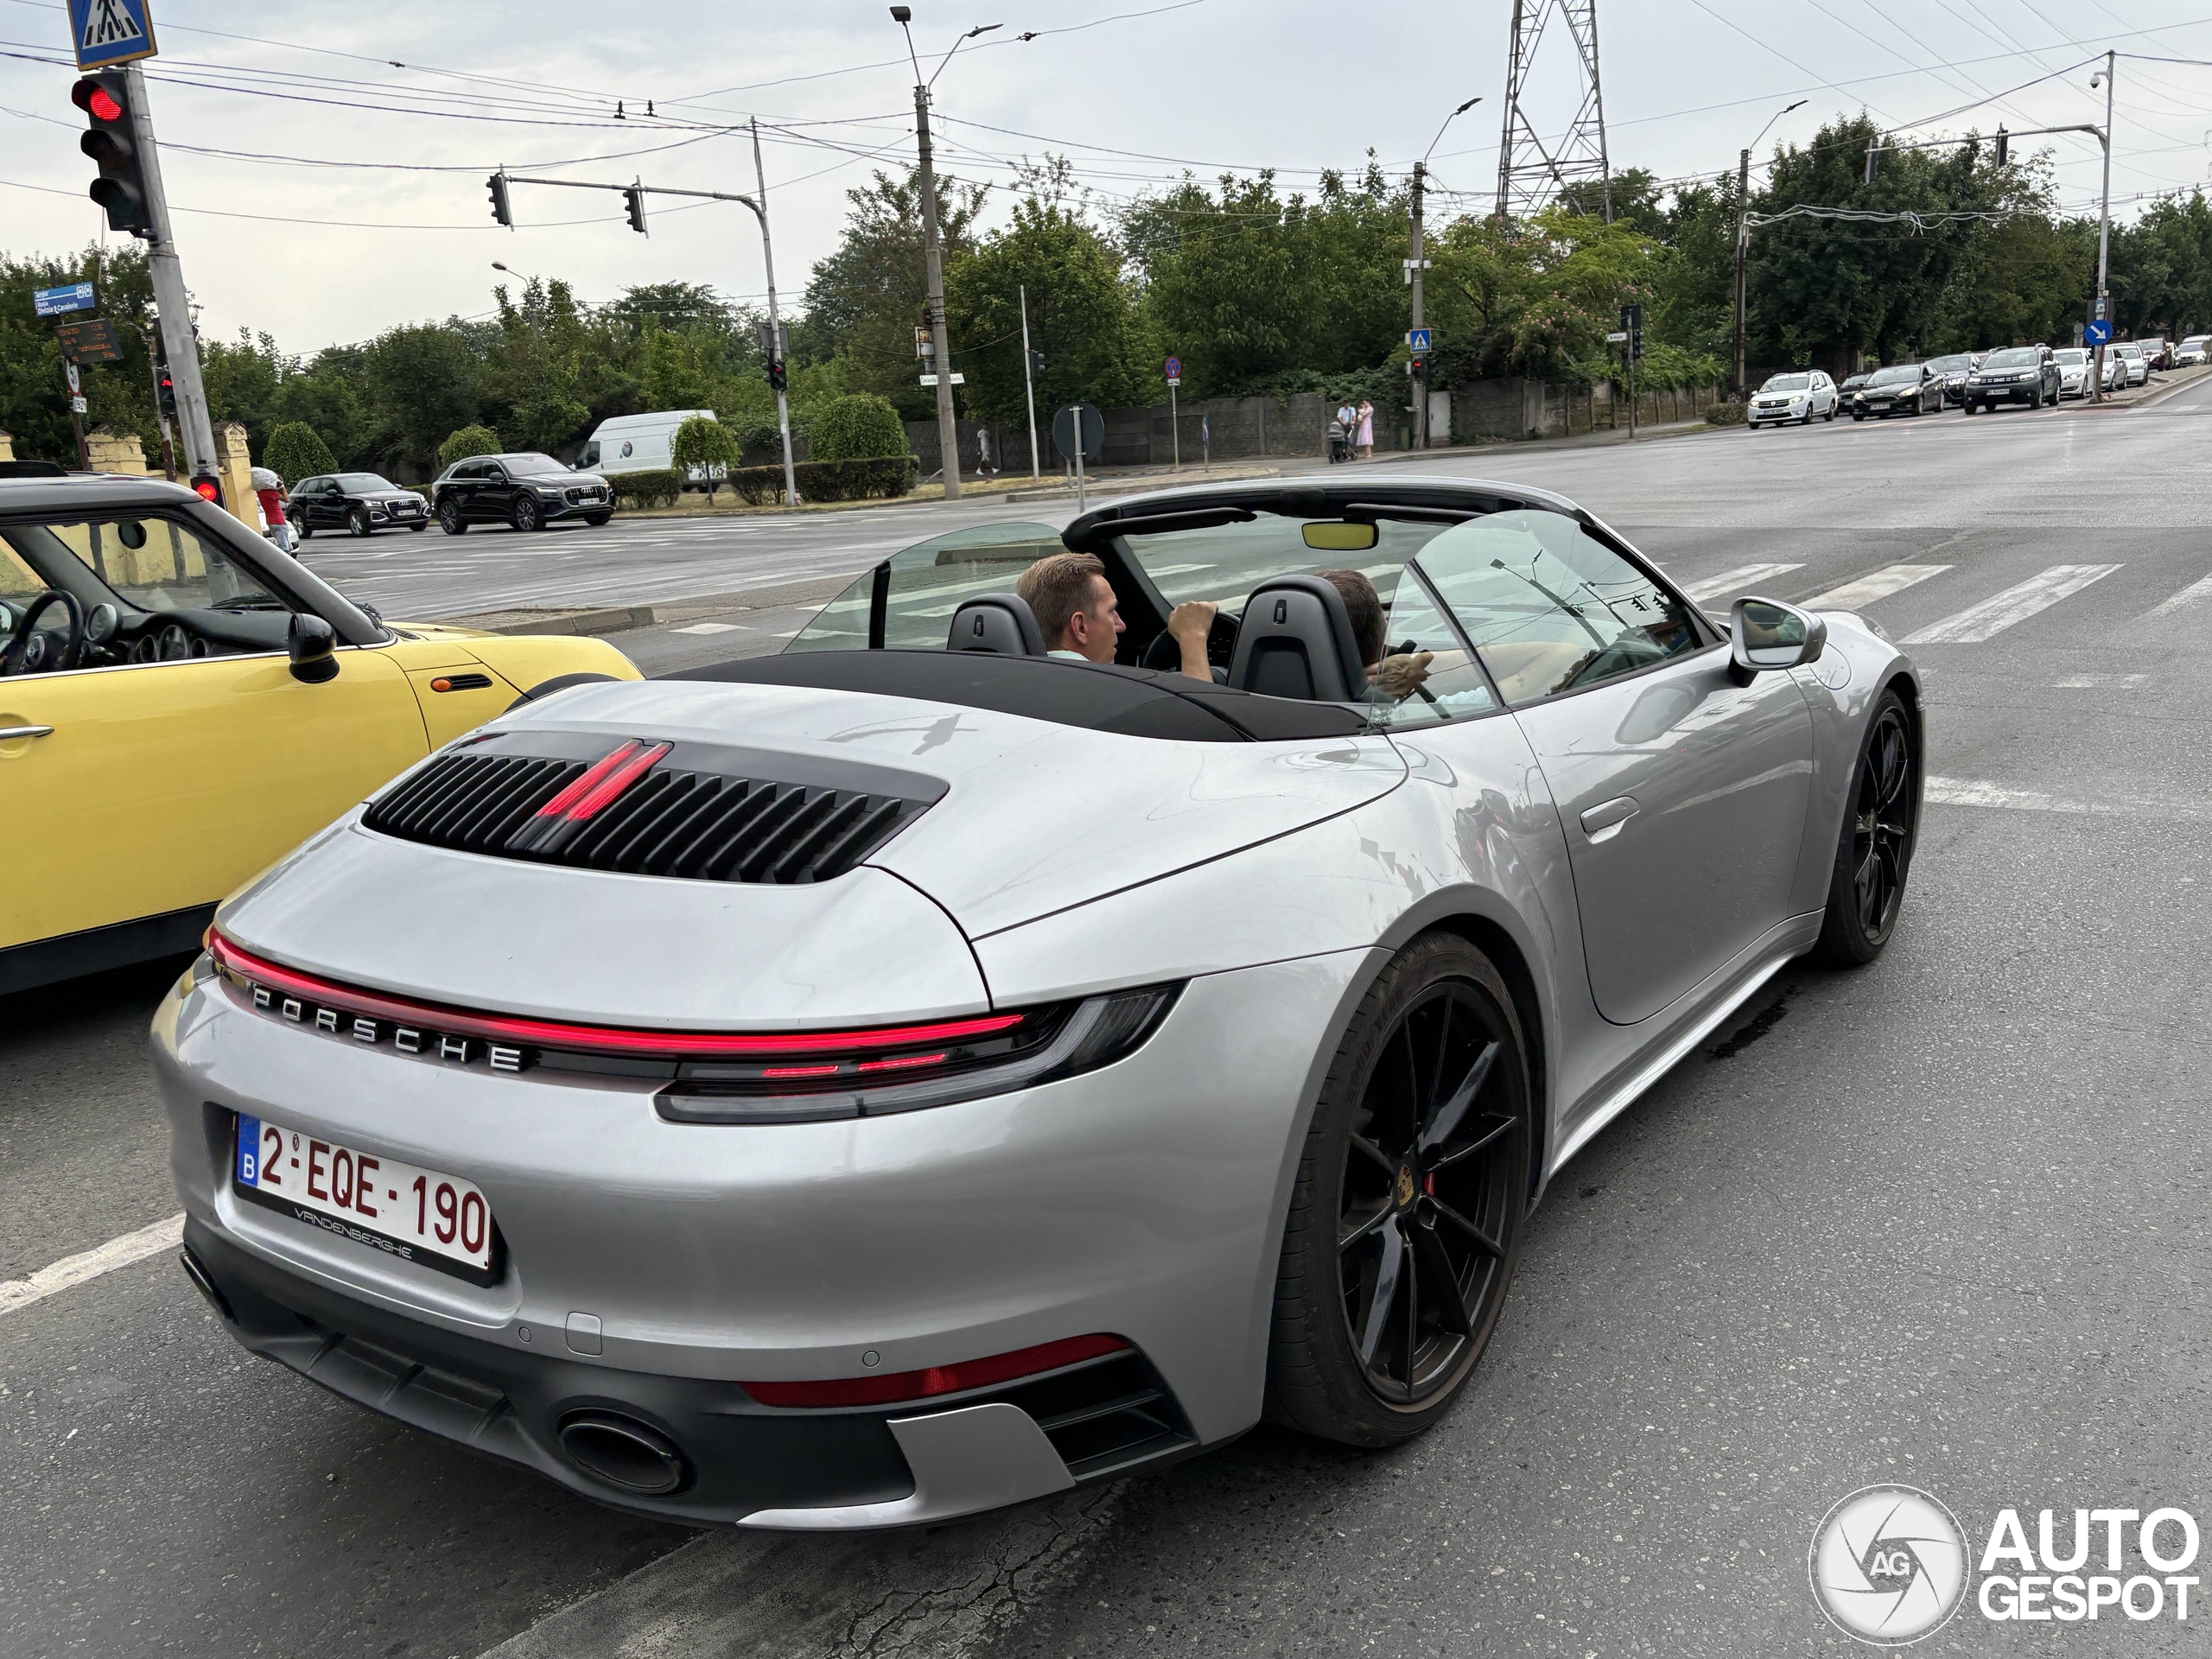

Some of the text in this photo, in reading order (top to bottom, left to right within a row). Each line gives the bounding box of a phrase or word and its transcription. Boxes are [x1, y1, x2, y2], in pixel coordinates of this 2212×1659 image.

[254, 988, 522, 1071] PORSCHE
[244, 1153, 255, 1179] B
[295, 1207, 412, 1259] VANDENBERGHE
